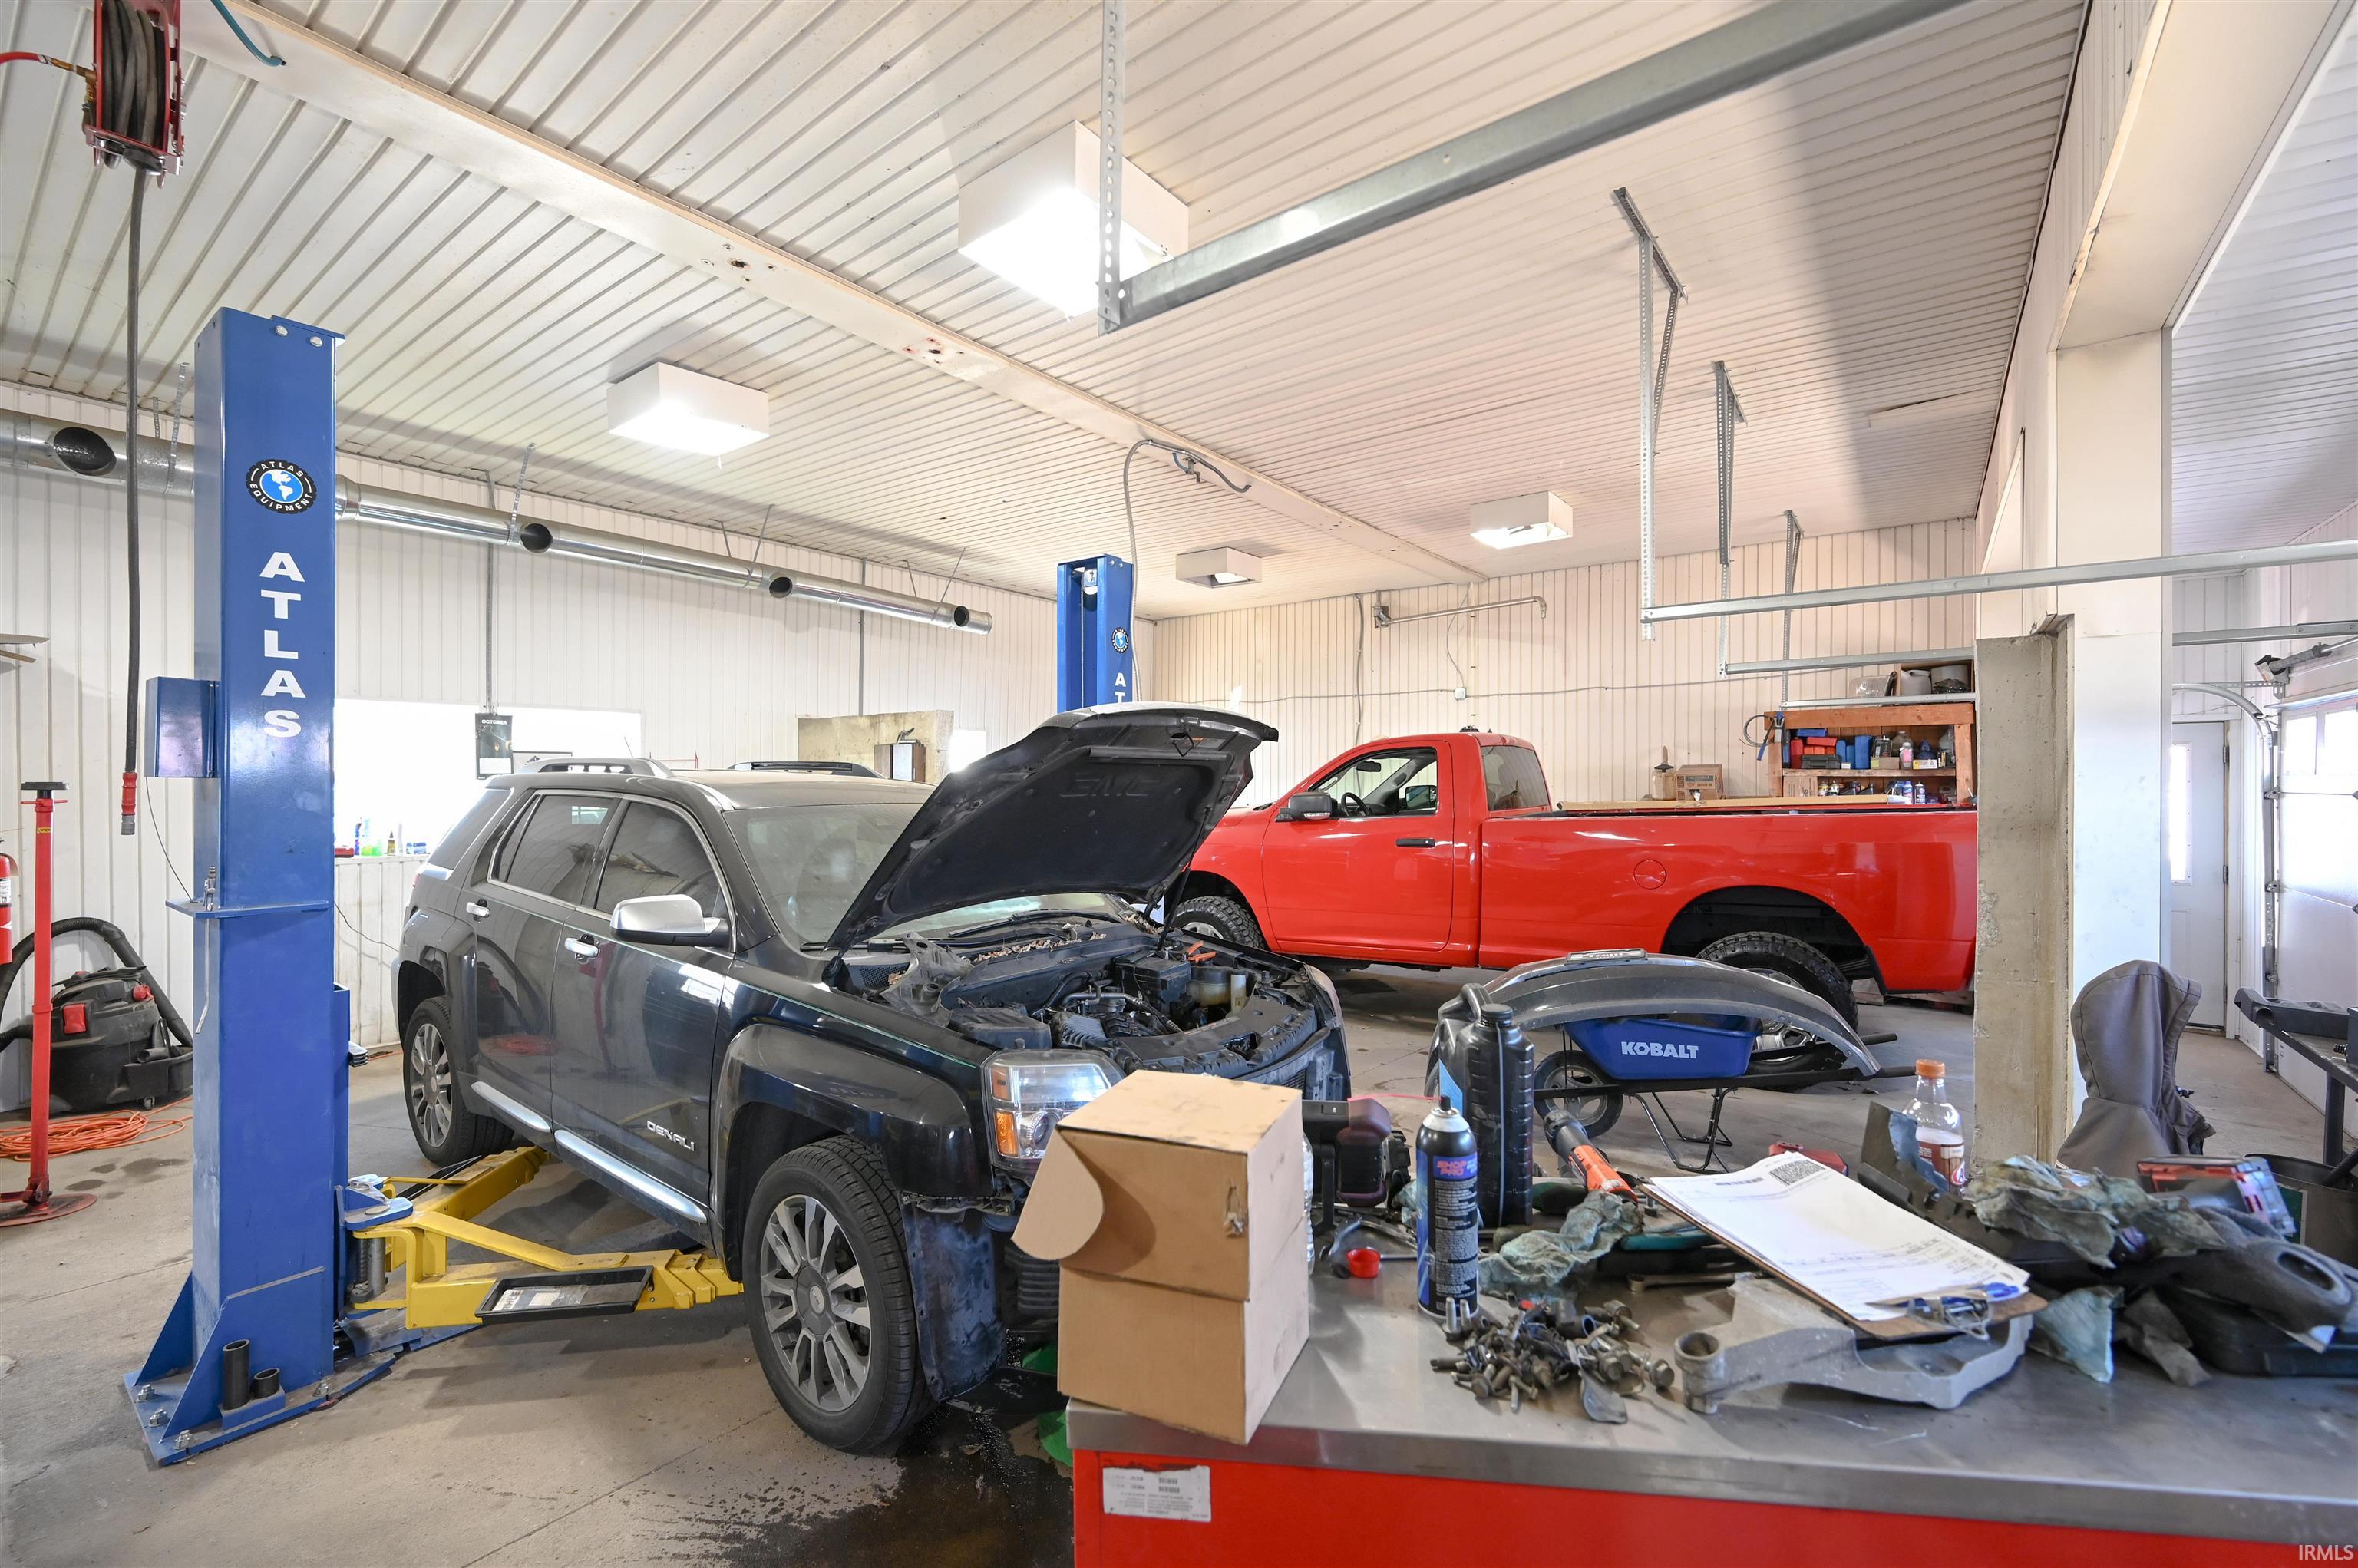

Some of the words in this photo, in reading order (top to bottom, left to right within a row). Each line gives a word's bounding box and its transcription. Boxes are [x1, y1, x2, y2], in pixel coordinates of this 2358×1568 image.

[261, 461, 304, 477] ATLAS
[249, 484, 312, 512] EQUIPMENT
[259, 551, 306, 738] ATLAS
[1621, 1041, 1699, 1059] KOBALT
[647, 1121, 695, 1151] DENALI
